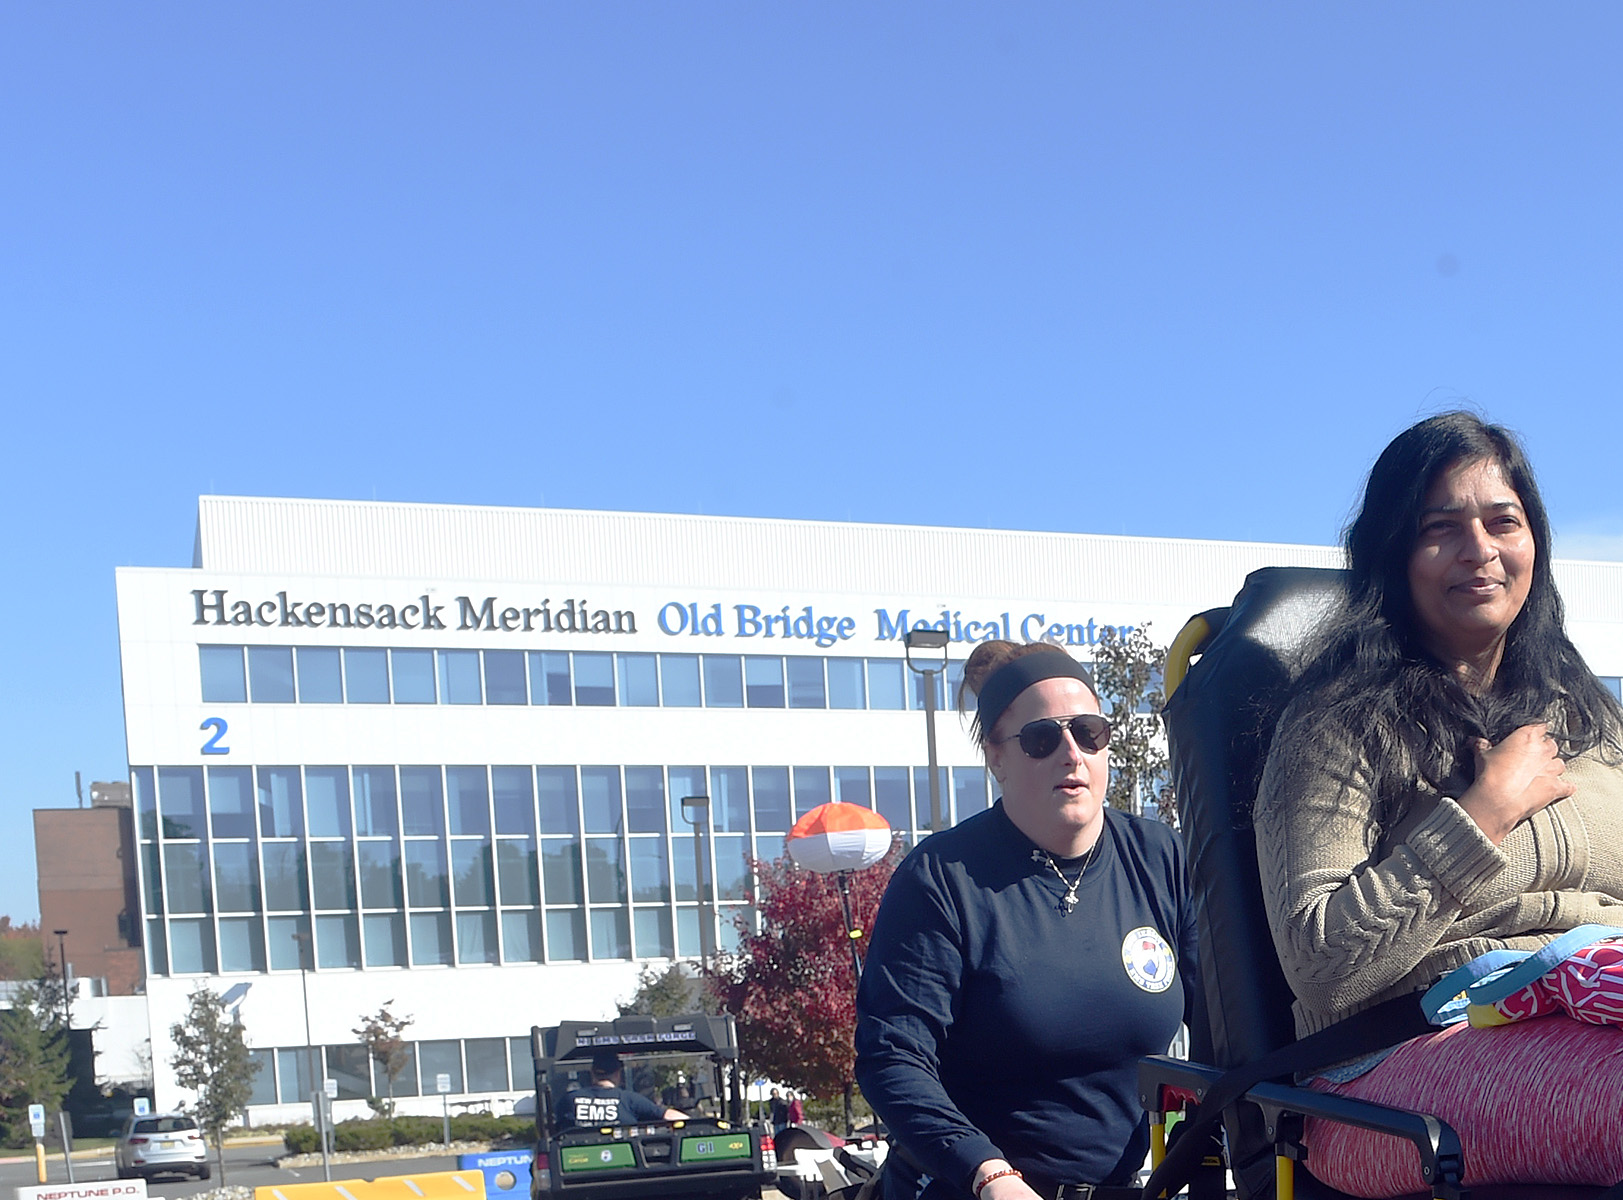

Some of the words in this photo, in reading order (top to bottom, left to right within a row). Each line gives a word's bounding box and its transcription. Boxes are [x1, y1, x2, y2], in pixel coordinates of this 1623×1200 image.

[190, 590, 446, 631] Hackensack
[455, 596, 638, 635] Meridian
[657, 601, 726, 637] Old
[734, 603, 857, 648] Bridge
[200, 717, 230, 755] 2
[621, 1033, 655, 1044] TASK
[657, 1032, 696, 1042] FORCE
[576, 1104, 618, 1121] EMS
[37, 1188, 109, 1200] NEPTUNE
